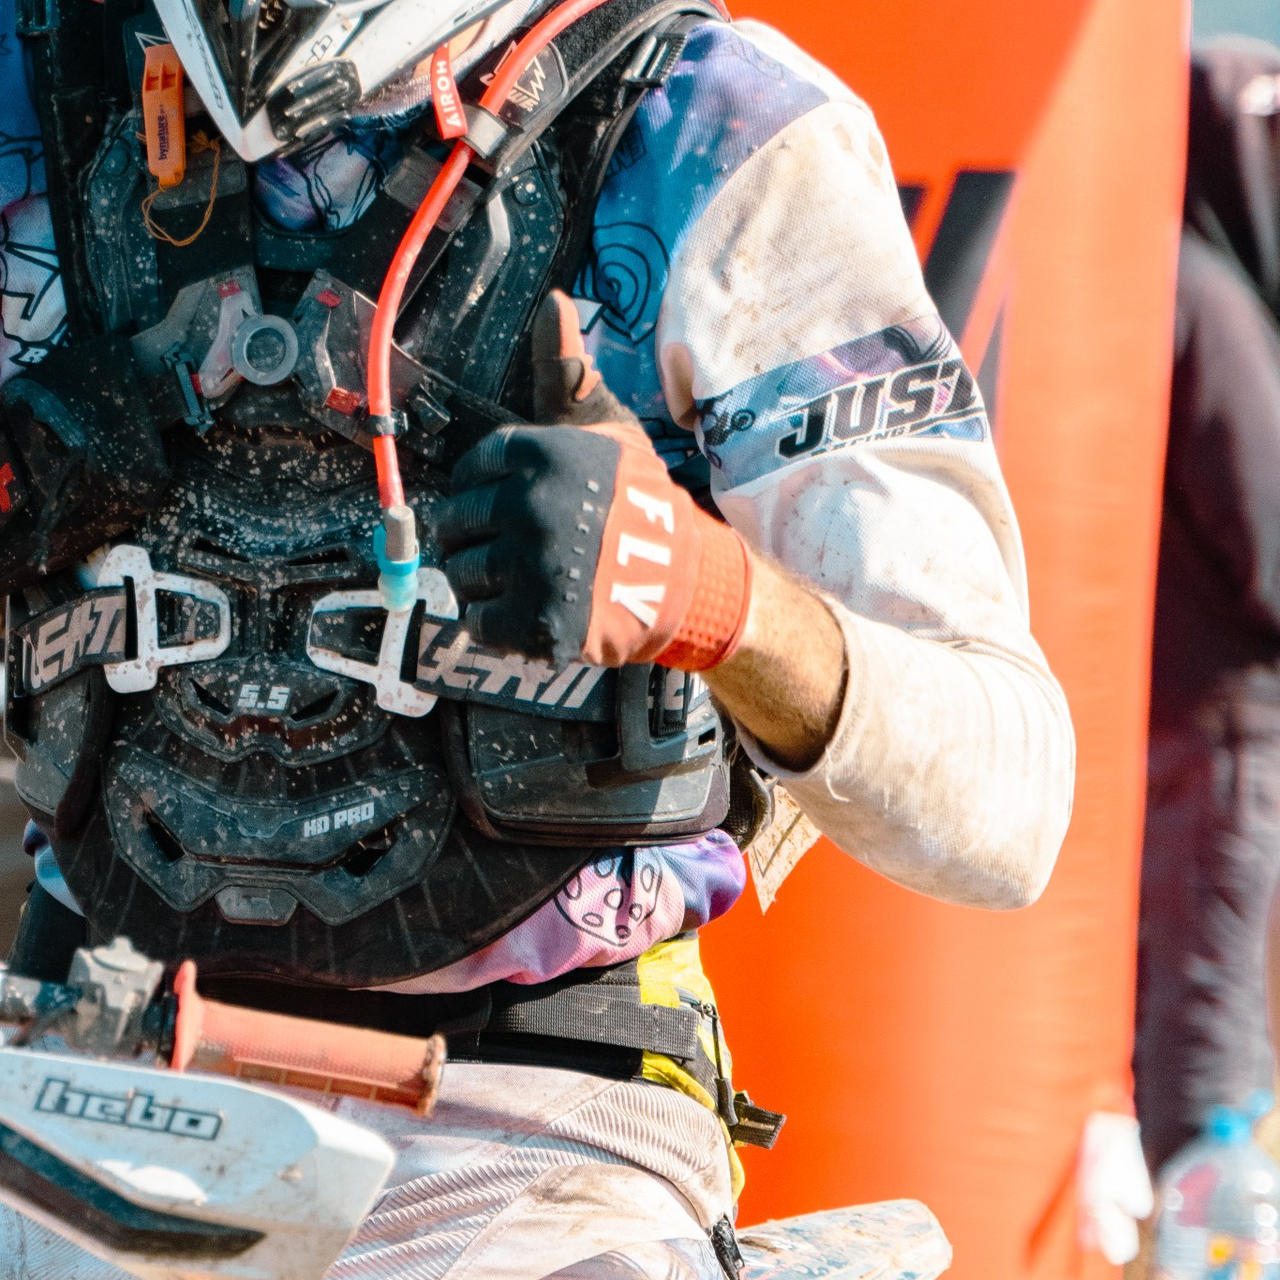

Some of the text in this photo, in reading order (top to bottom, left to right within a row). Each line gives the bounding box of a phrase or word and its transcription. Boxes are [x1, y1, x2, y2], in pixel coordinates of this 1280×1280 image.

[436, 60, 462, 127] AIROH
[610, 486, 675, 628] FLY
[236, 684, 291, 711] 5.5
[304, 802, 375, 838] HD PRO
[33, 1077, 223, 1141] hebo
